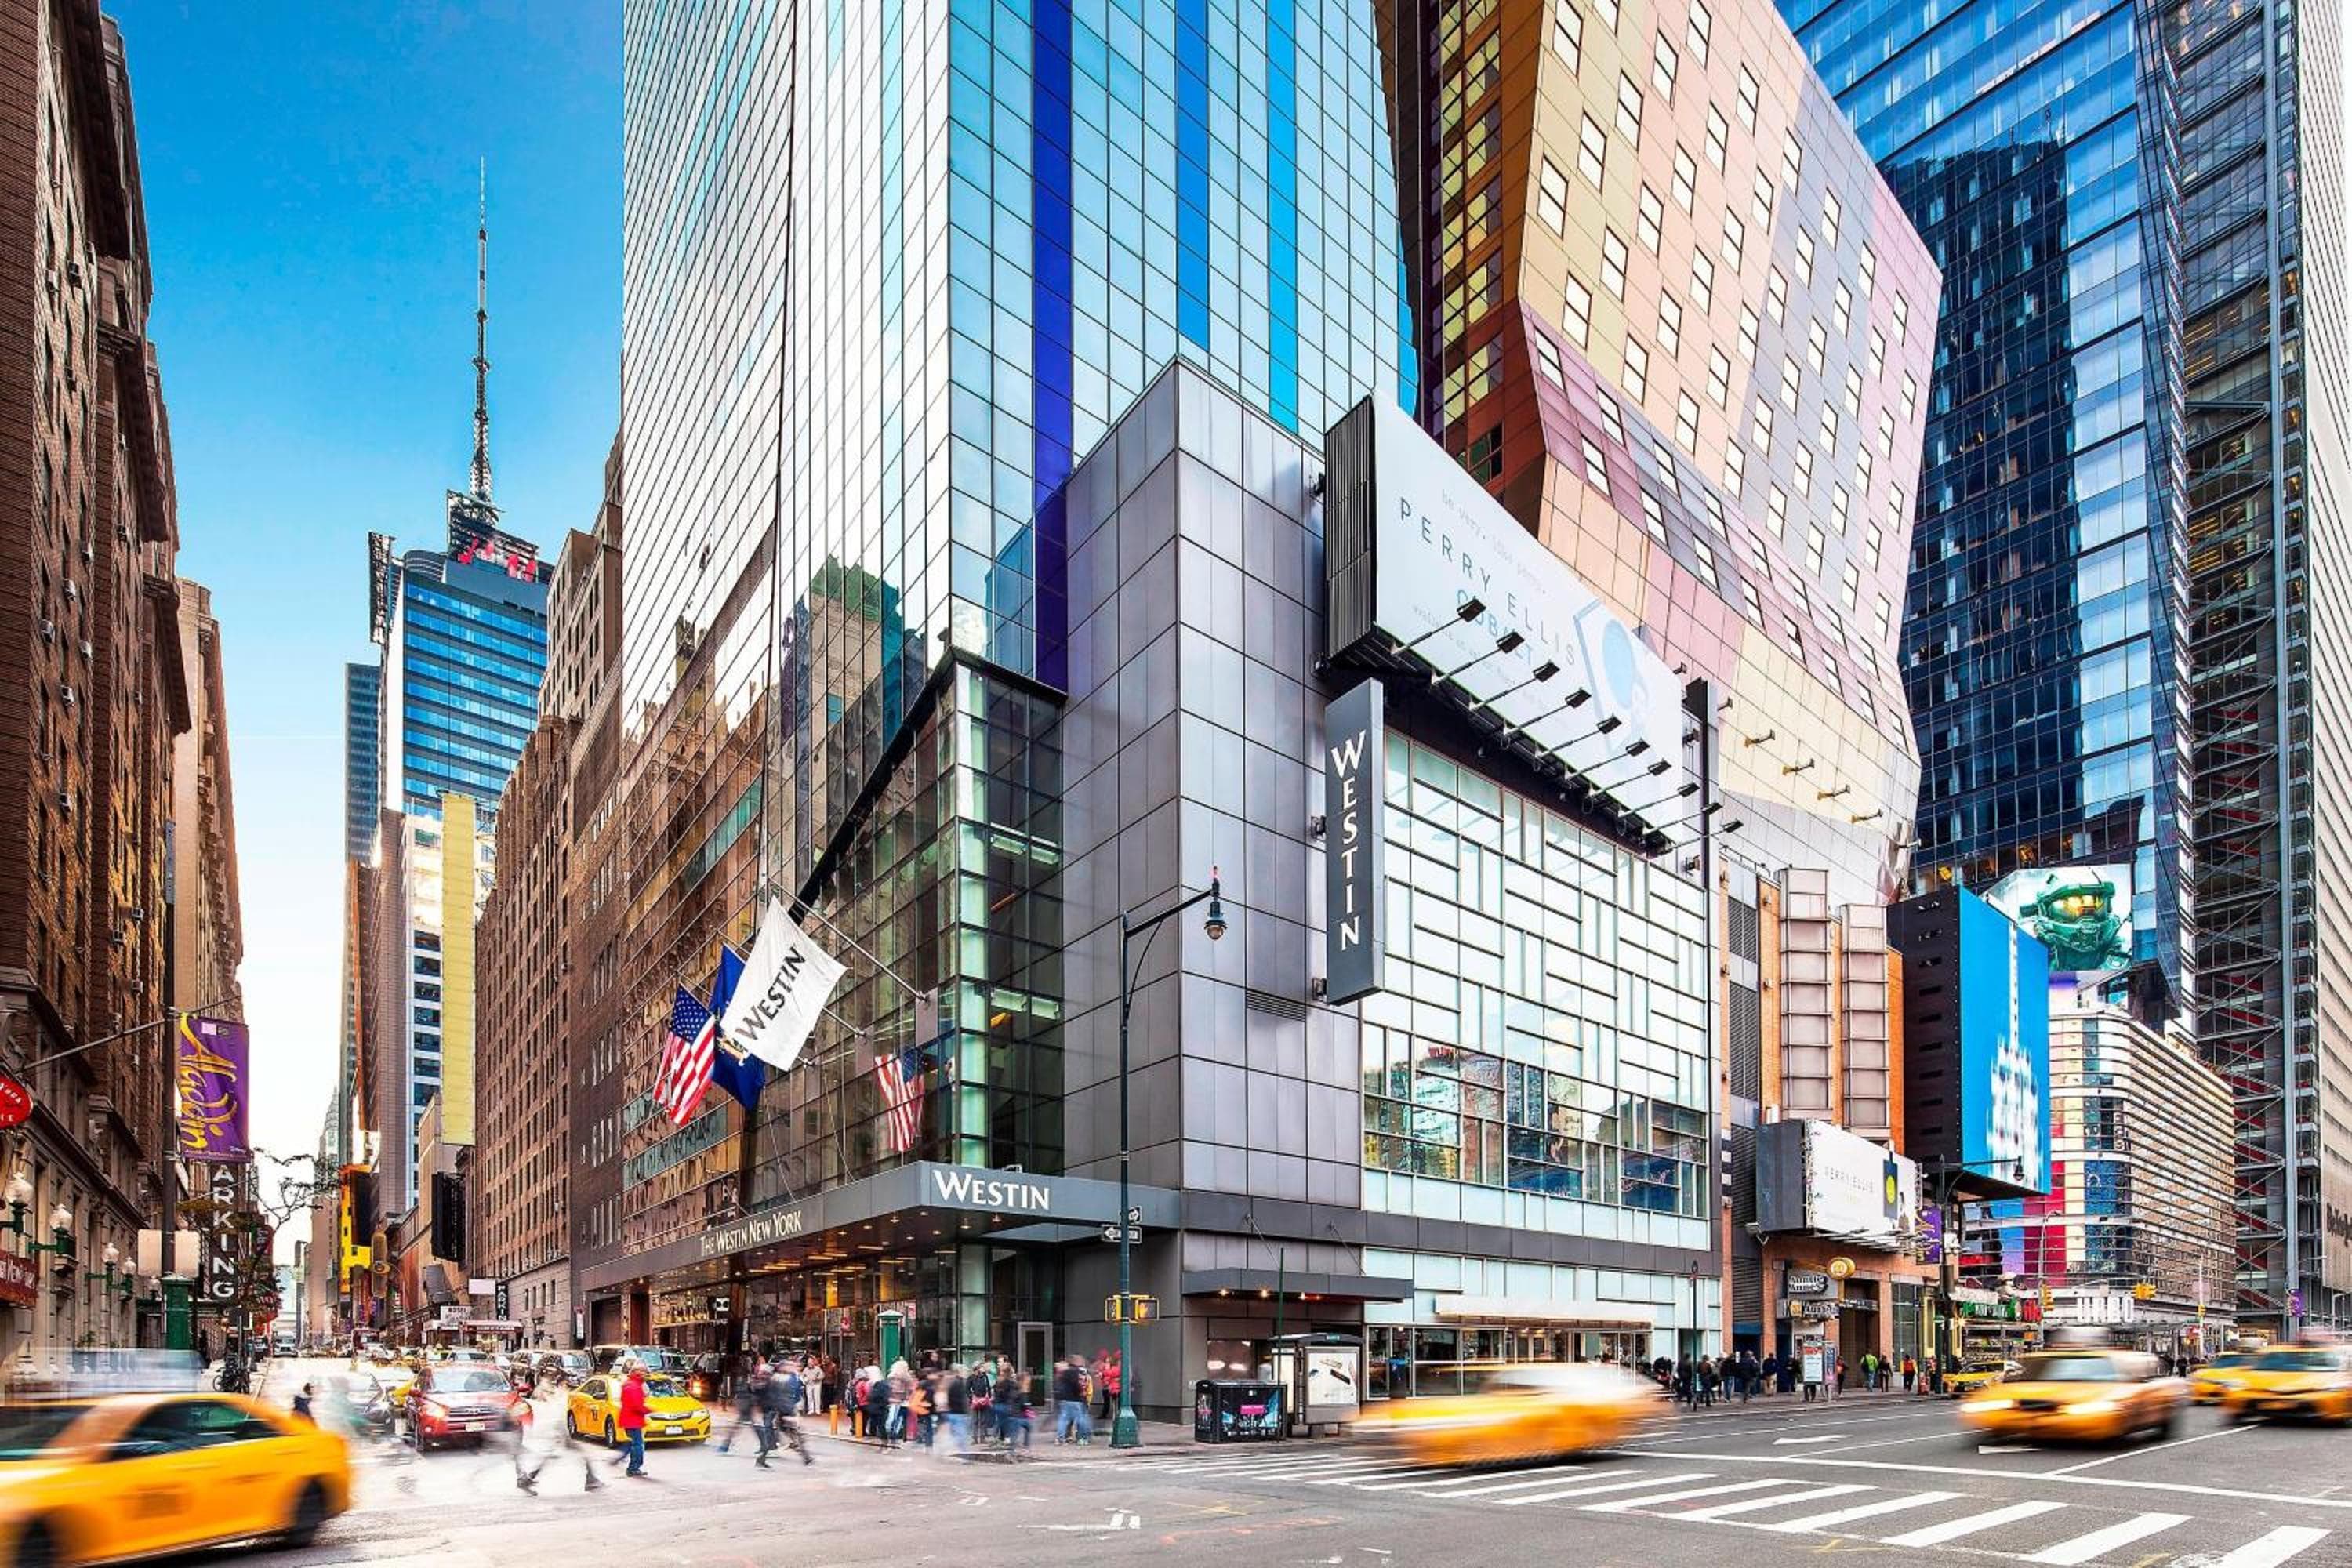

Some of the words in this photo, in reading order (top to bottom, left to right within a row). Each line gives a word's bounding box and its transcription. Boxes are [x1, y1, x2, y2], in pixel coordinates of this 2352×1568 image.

[1401, 496, 1490, 593] PERRY
[1507, 592, 1575, 666] ELLIS
[1331, 729, 1367, 952] WESTIN
[735, 943, 807, 1040] WESTIN
[180, 1011, 238, 1149] Aladdin
[212, 1163, 235, 1298] ARKING
[700, 1234, 715, 1257] THE
[716, 1226, 747, 1253] WESTIN
[749, 1219, 772, 1244] NEW
[772, 1210, 802, 1237] YORK
[931, 1169, 1051, 1211] WESTIN
[497, 1285, 507, 1321] PARKIN
[2077, 1297, 2135, 1323] URBO
